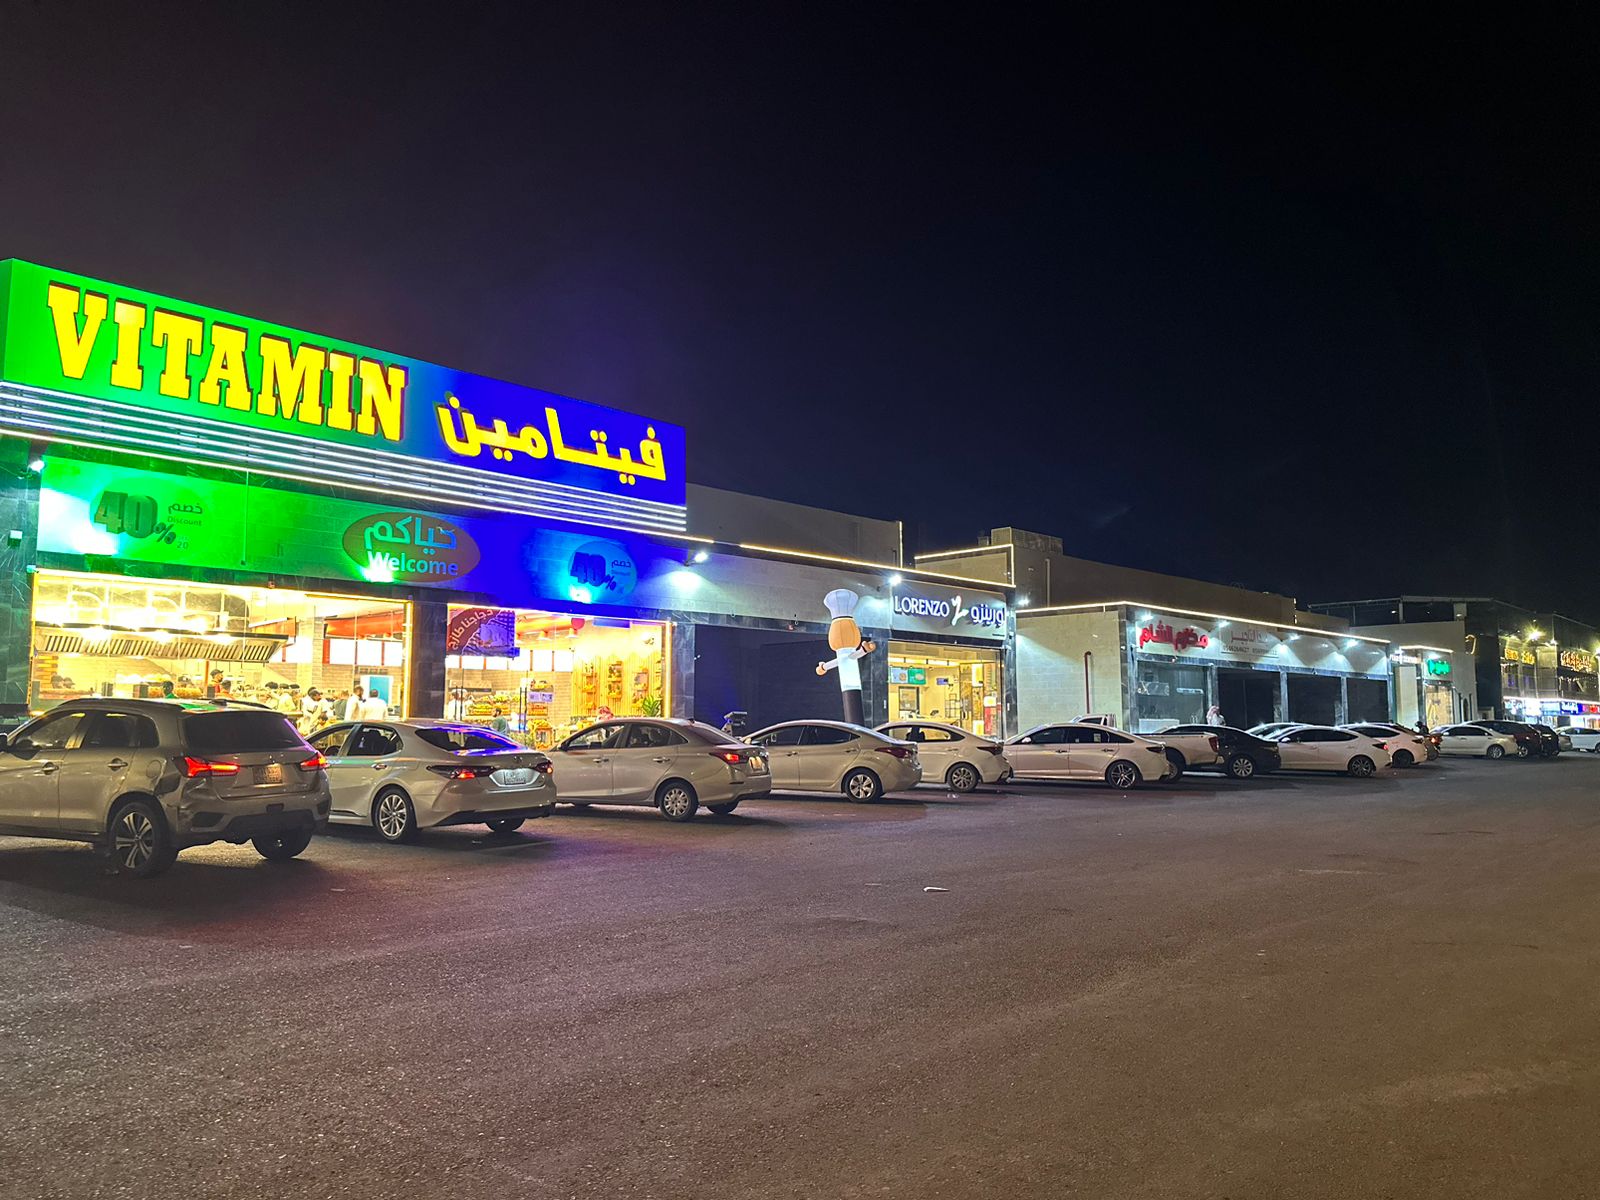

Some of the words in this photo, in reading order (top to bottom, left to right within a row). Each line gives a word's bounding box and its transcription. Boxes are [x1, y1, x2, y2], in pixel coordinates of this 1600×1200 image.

[47, 280, 409, 442] VITAMIN
[436, 391, 667, 486] فيتامين
[167, 501, 204, 515] خصم
[167, 515, 203, 526] Discount
[363, 515, 457, 555] حياكم
[366, 550, 459, 576] Welcome
[611, 558, 632, 569] خصم
[893, 595, 950, 618] LORENZO
[460, 609, 495, 629] دجاجنا
